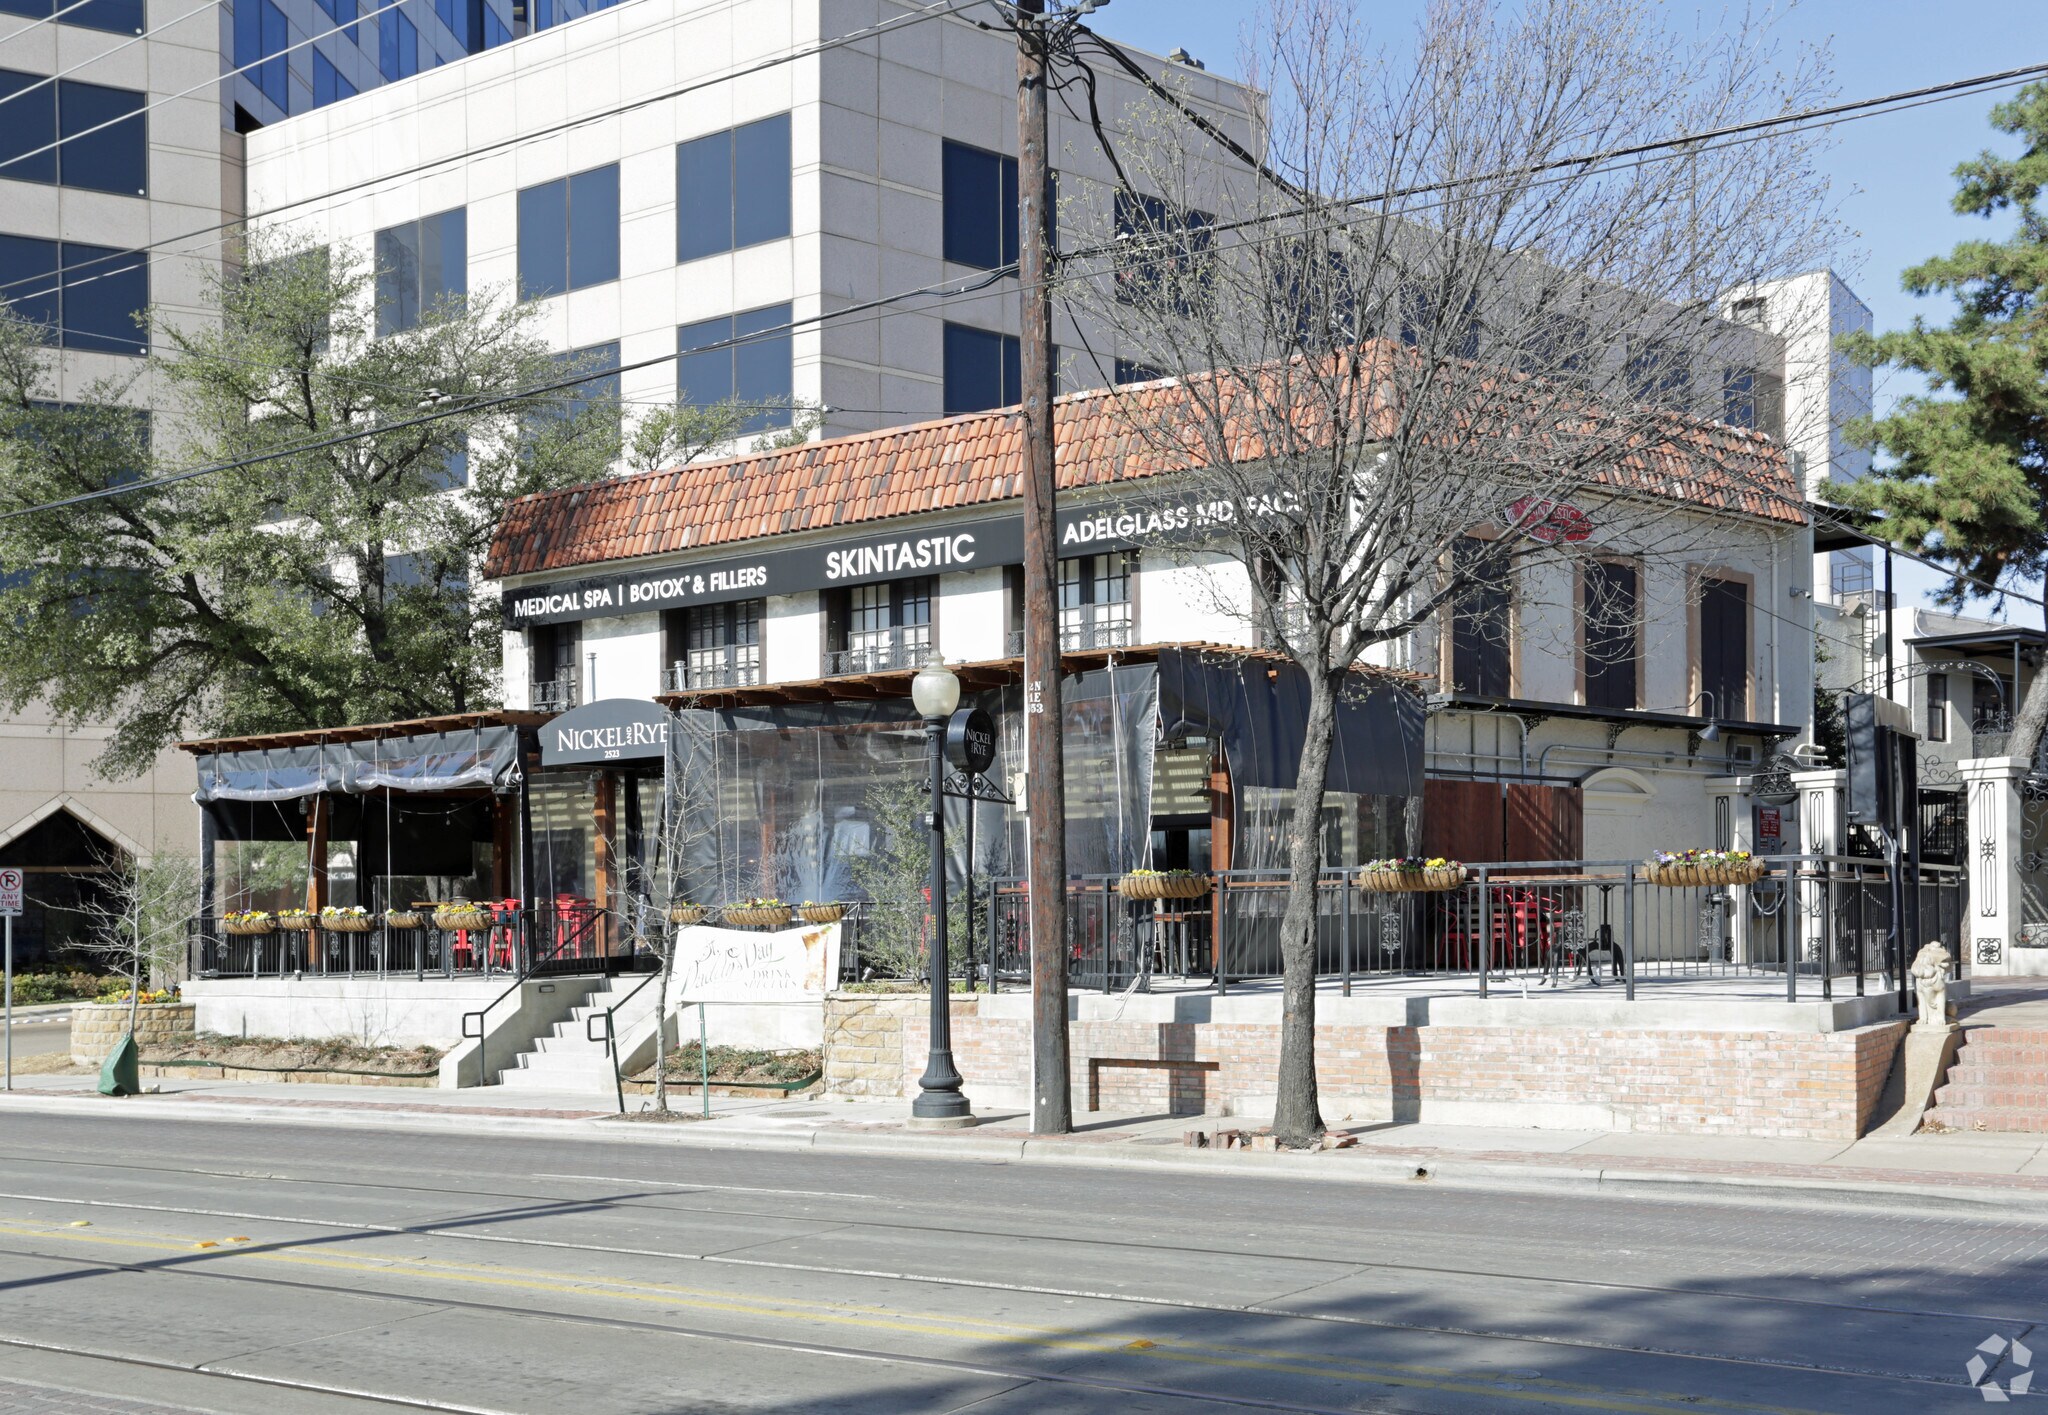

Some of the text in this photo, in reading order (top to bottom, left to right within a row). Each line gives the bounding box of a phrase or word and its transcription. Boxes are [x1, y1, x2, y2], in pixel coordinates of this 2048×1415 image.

[1063, 506, 1189, 545] ADELGLASS
[826, 533, 975, 579] SKINTASTIC
[514, 592, 581, 618] MEDICAL
[584, 588, 612, 609] SPA
[692, 574, 705, 594] &
[710, 565, 767, 592] FILLERS
[558, 727, 626, 752] NICKEL
[632, 722, 668, 745] RYE
[966, 728, 991, 745] NICKEL
[973, 742, 986, 756] RYE
[604, 750, 620, 759] 2523
